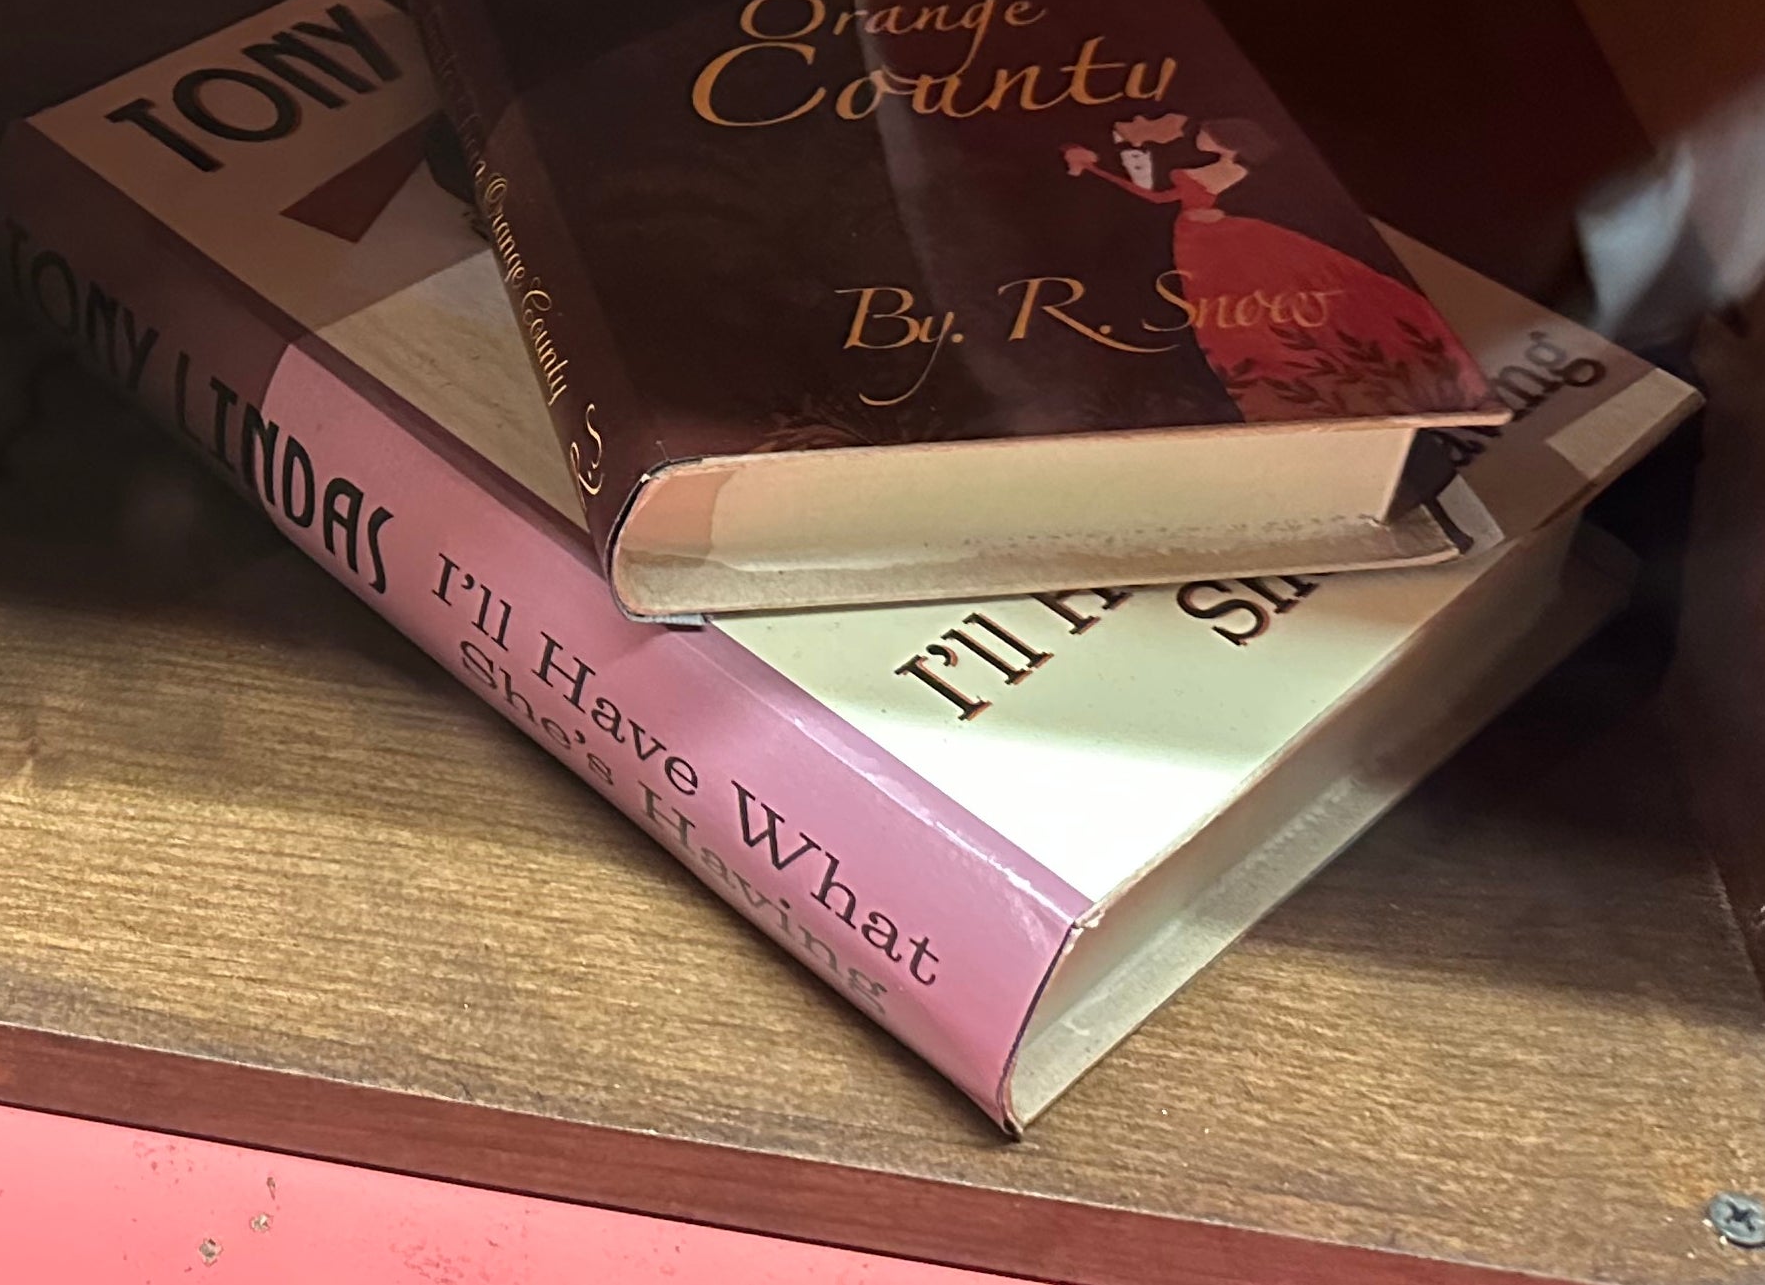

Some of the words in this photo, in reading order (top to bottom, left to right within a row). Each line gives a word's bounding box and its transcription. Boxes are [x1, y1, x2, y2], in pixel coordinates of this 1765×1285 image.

[105, 3, 403, 173] TONY
[5, 217, 160, 392] TONY
[172, 349, 395, 595] LINDAS
[523, 276, 570, 406] County
[834, 285, 965, 406] By.
[997, 276, 1180, 353] R.
[1140, 268, 1344, 332] Snow
[893, 612, 1055, 721] I'll
[430, 552, 514, 653] I'll
[531, 630, 700, 798] Have
[730, 779, 942, 988] What
[459, 640, 615, 787] She's
[635, 781, 890, 1017] Having
